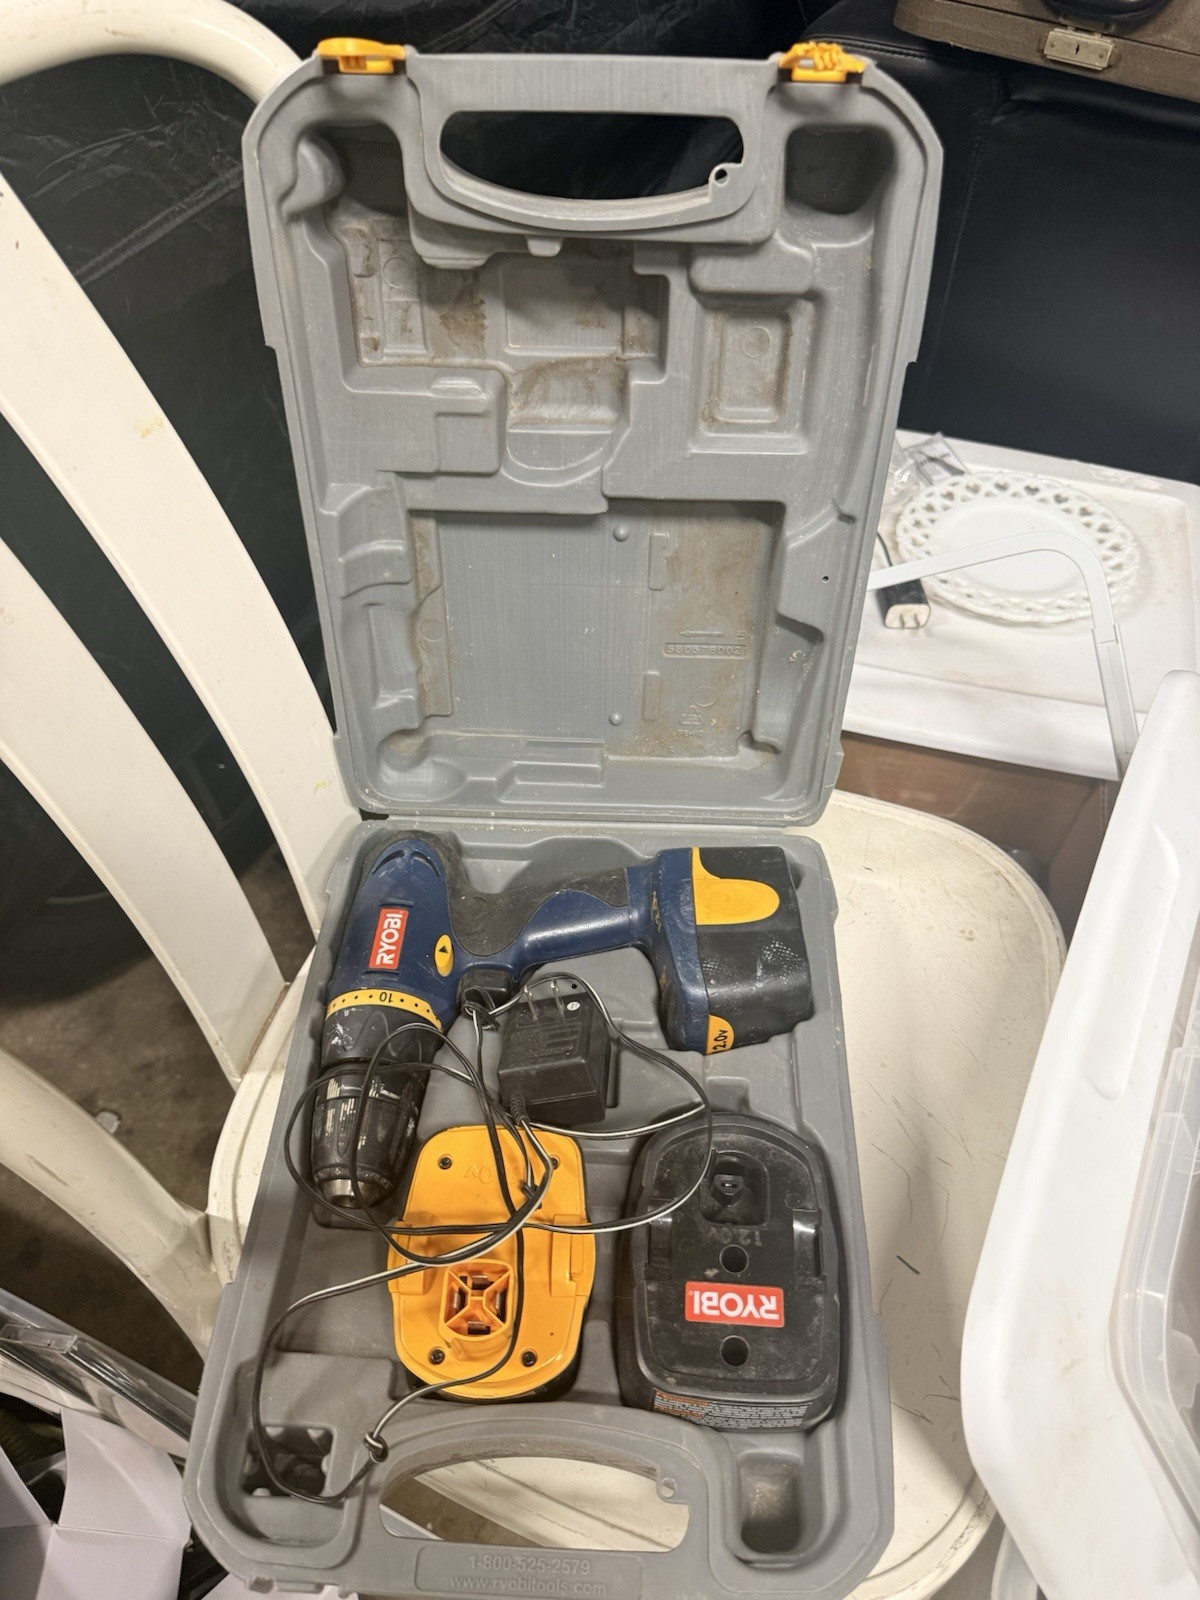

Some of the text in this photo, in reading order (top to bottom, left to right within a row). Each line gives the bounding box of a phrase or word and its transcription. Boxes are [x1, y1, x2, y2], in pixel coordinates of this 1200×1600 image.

[376, 914, 403, 966] RYOBI
[379, 991, 394, 1004] 10
[693, 1290, 779, 1320] RYOBI
[469, 1555, 591, 1575] 1-800-525-2579
[450, 1576, 607, 1595] www.ryobitools.com
